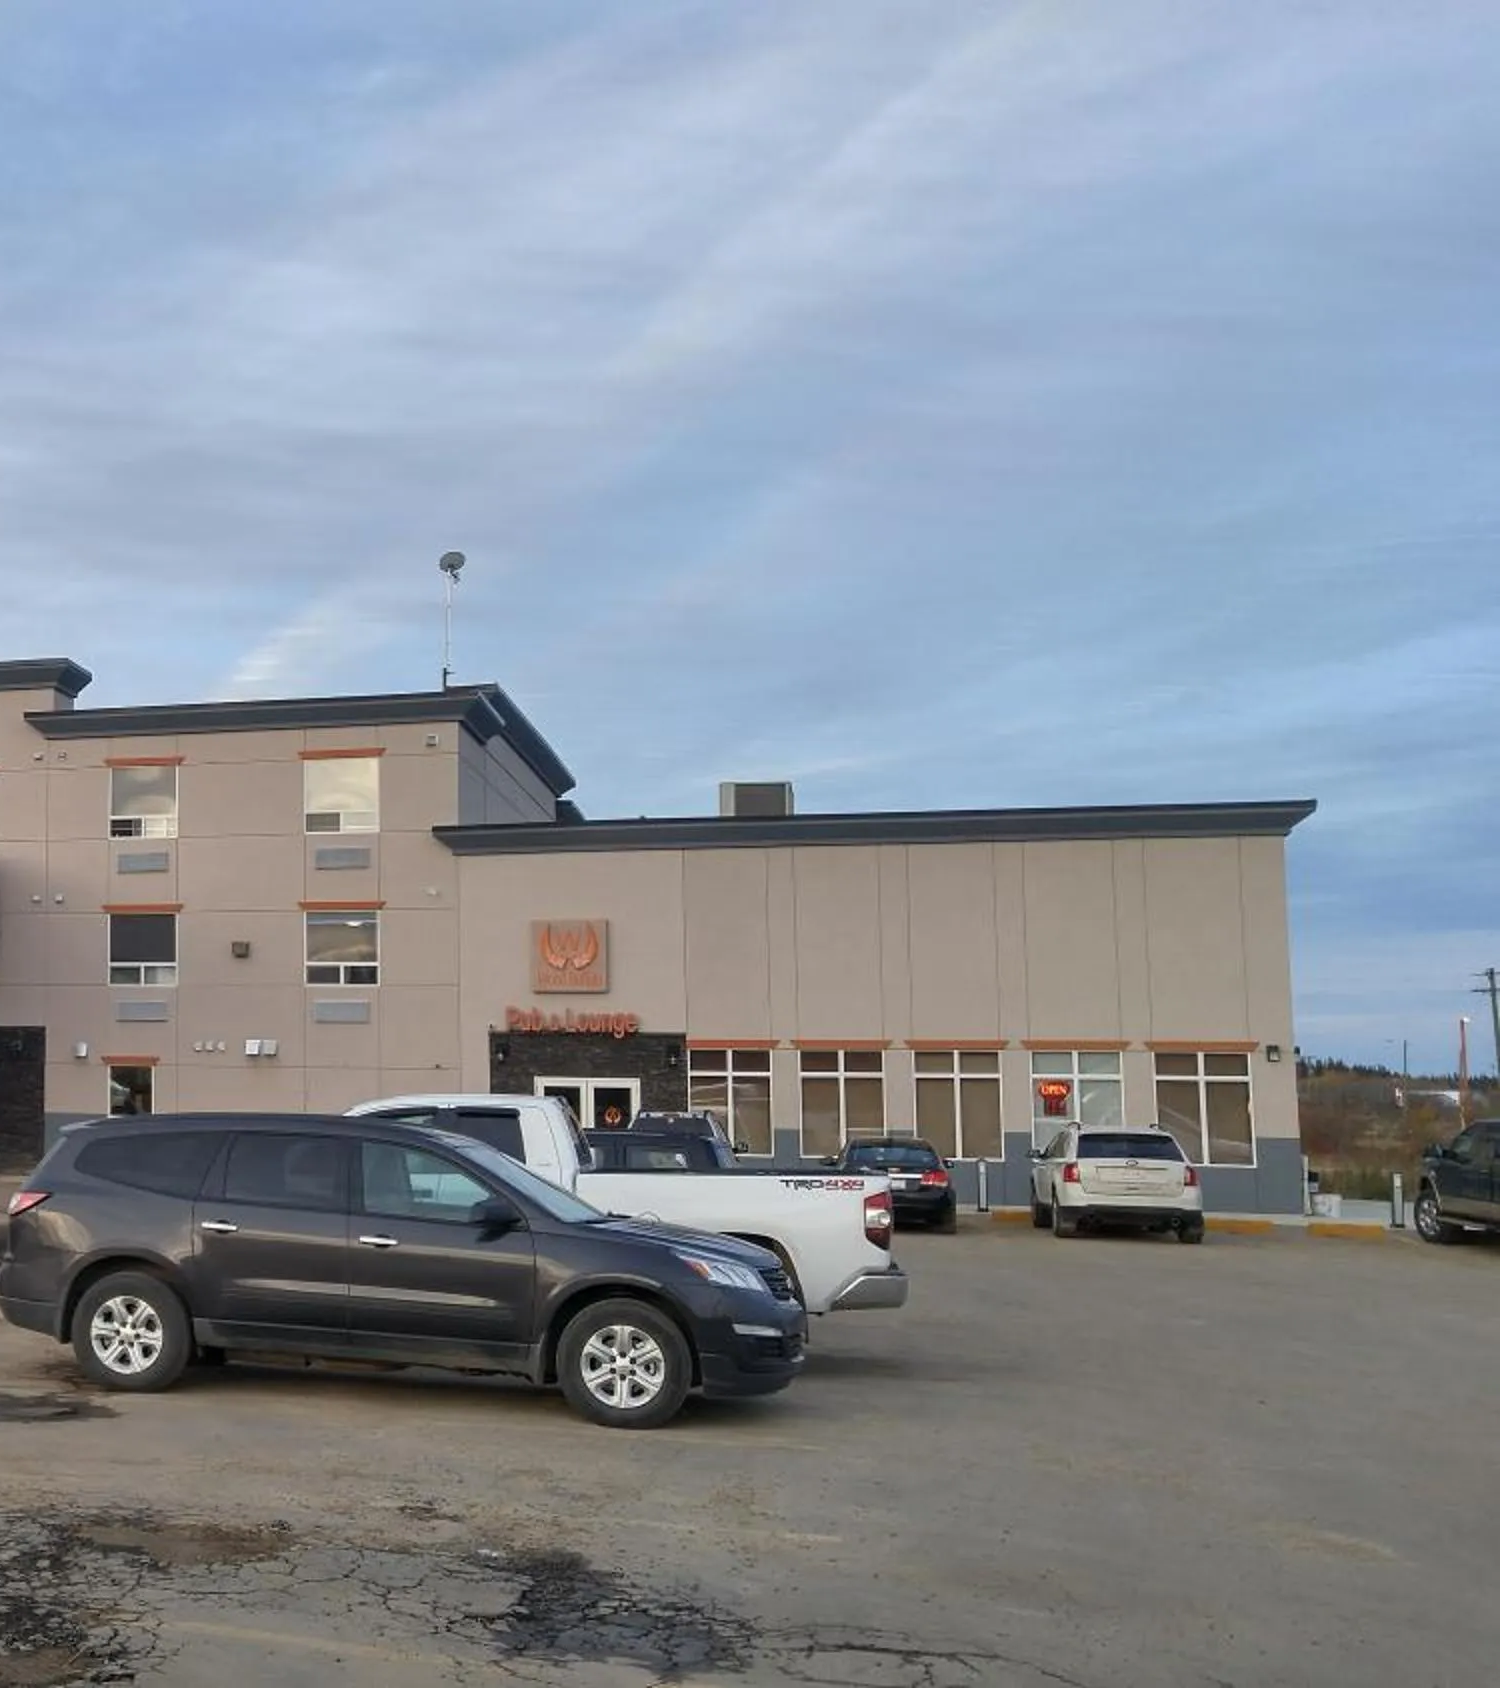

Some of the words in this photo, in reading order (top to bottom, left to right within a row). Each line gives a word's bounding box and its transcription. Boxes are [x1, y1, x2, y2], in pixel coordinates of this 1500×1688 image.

[505, 1005, 544, 1033] Pub
[565, 1007, 639, 1039] Lounge
[1041, 1083, 1068, 1096] OPEN
